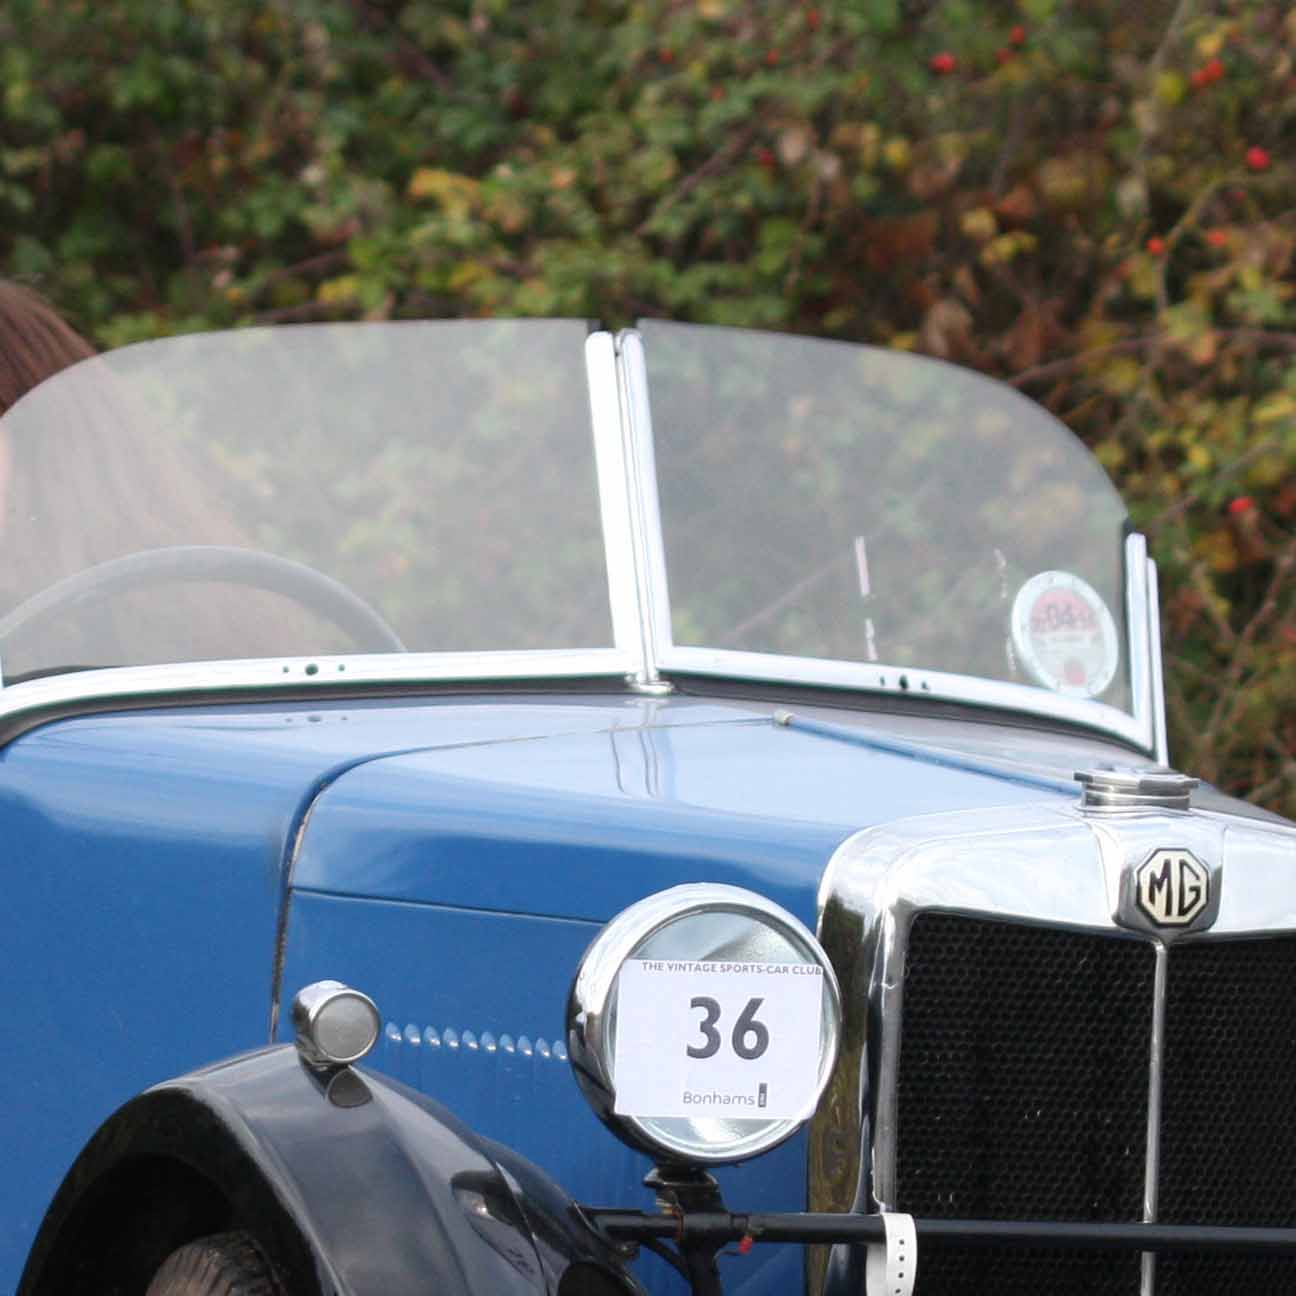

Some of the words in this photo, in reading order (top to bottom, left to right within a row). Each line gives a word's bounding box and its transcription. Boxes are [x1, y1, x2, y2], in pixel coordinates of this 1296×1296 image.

[1148, 859, 1201, 917] MG
[642, 961, 664, 972] THE
[668, 962, 717, 974] VINTAGE
[720, 963, 789, 975] SPORTS-CAR
[792, 965, 822, 976] CLUB
[686, 996, 769, 1060] 36
[683, 1090, 755, 1105] Bonhams
